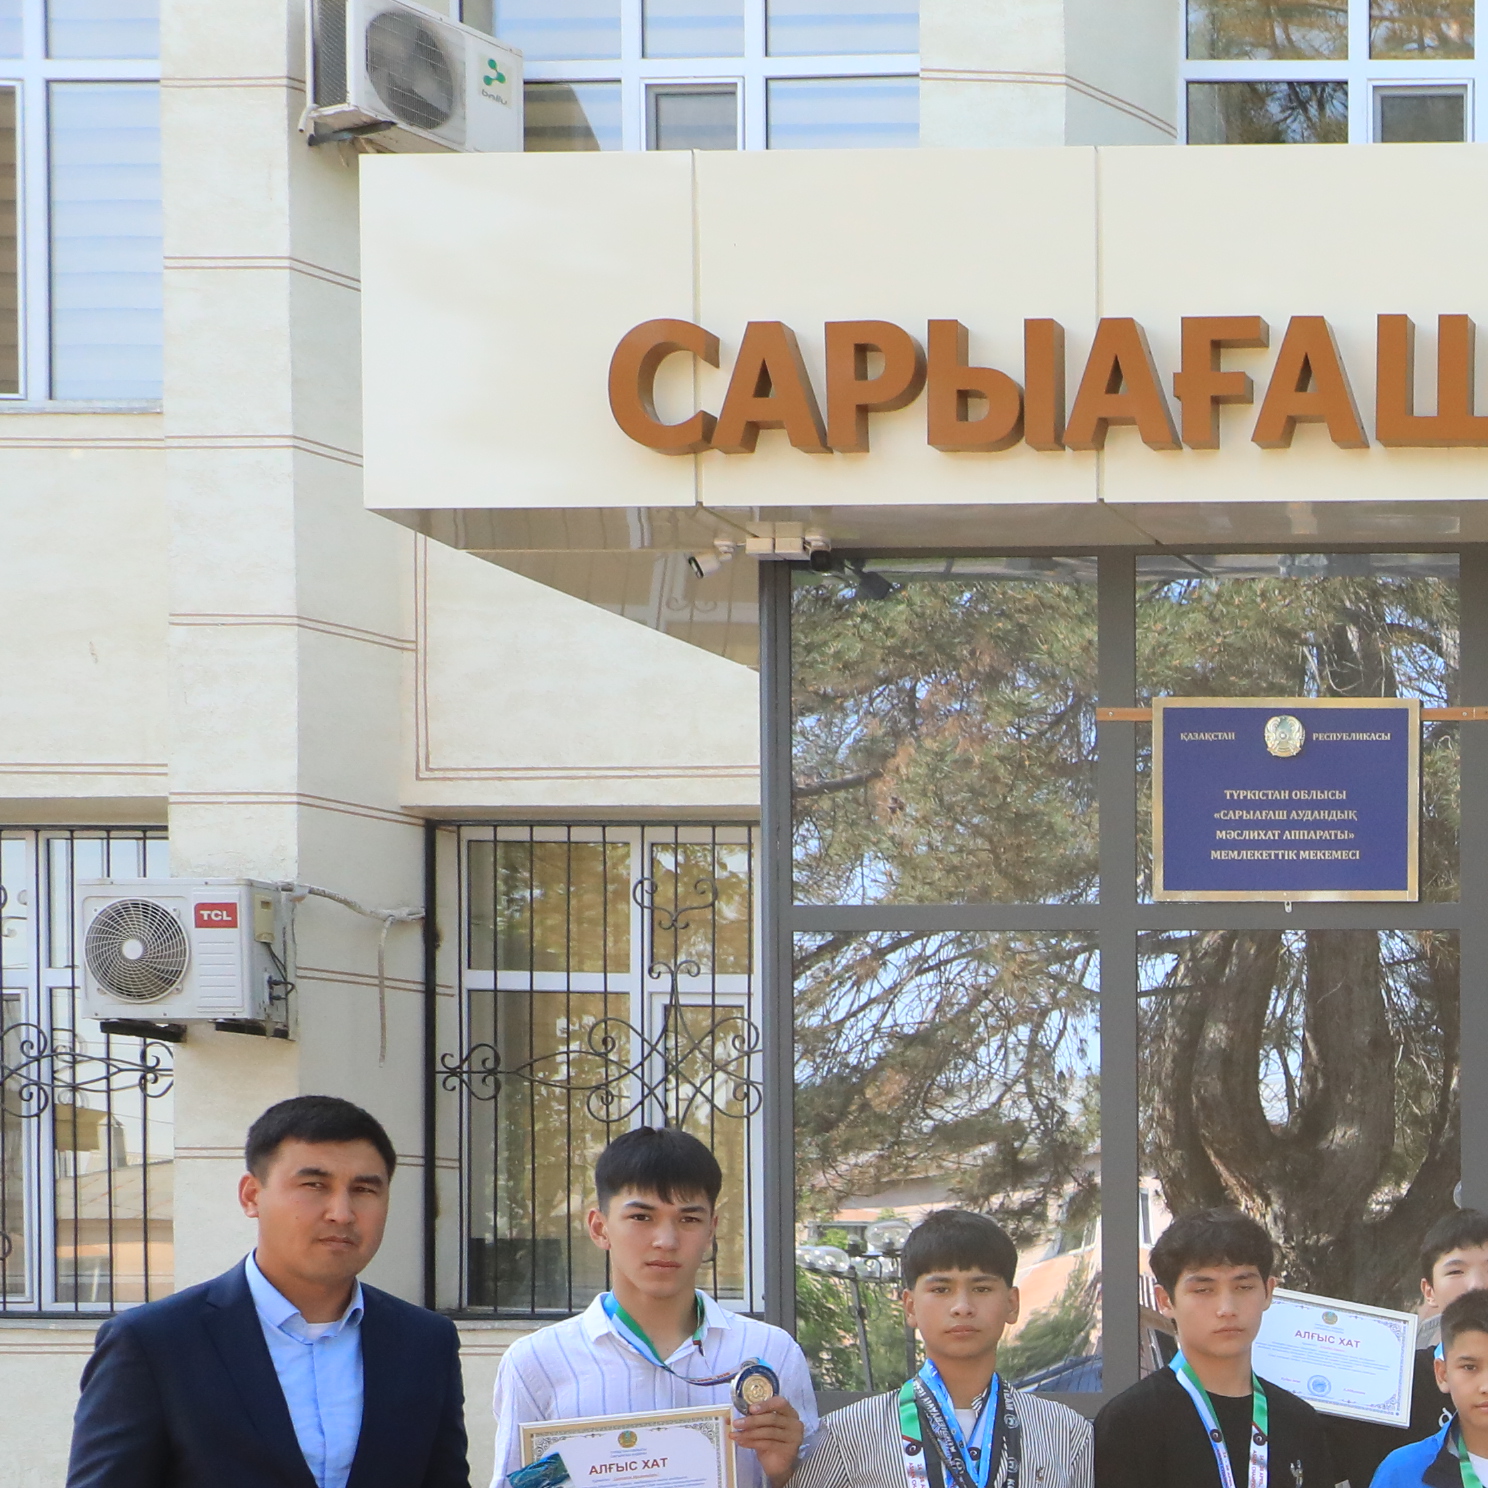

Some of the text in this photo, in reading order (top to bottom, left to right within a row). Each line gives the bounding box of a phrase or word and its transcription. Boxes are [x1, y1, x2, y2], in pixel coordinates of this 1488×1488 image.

[1180, 732, 1391, 741] ҚАЗАҚСТАН РЕСПУБЛИКАСЫ
[1224, 790, 1346, 800] ТҮРКІСТАН ОБЛЫСЫ
[1214, 810, 1357, 822] «САРЫАҒАШ АУДАНДЫҚ
[1216, 830, 1354, 840] МӘСЛИХАТ АППАРАТЫ»
[1210, 850, 1360, 860] МЕМЛЕКЕТТІК МЕКЕМЕСІ
[199, 909, 232, 921] TCL
[1338, 1338, 1361, 1348] ХАТ
[589, 1458, 668, 1475] АЛҒЫС ХАТ
